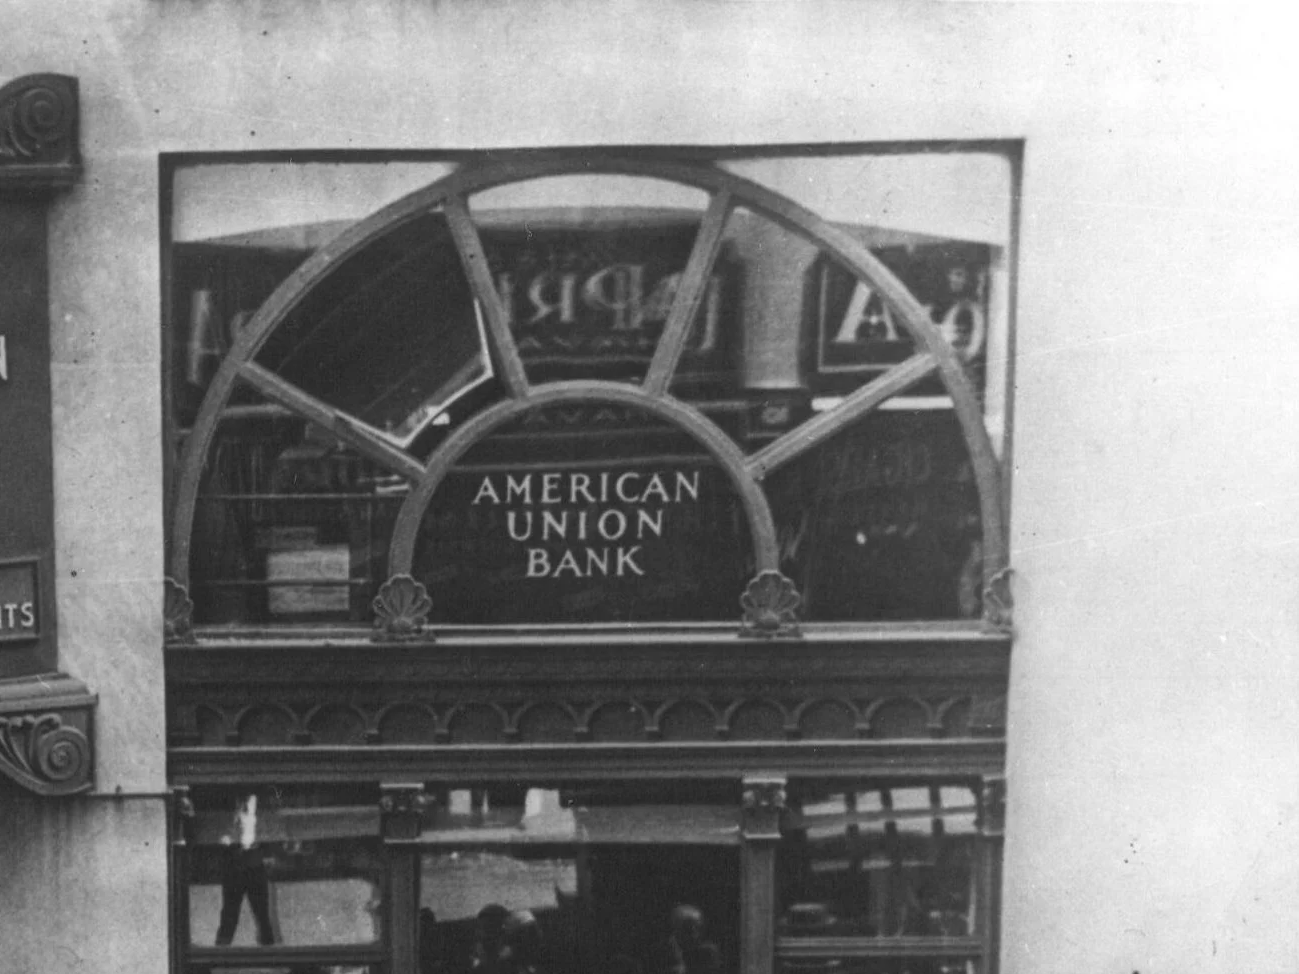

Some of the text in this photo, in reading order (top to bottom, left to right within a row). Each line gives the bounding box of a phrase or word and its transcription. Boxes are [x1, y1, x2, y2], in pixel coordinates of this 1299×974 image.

[472, 471, 699, 505] AMERICAN
[507, 509, 663, 541] UNION
[526, 545, 645, 578] BANK
